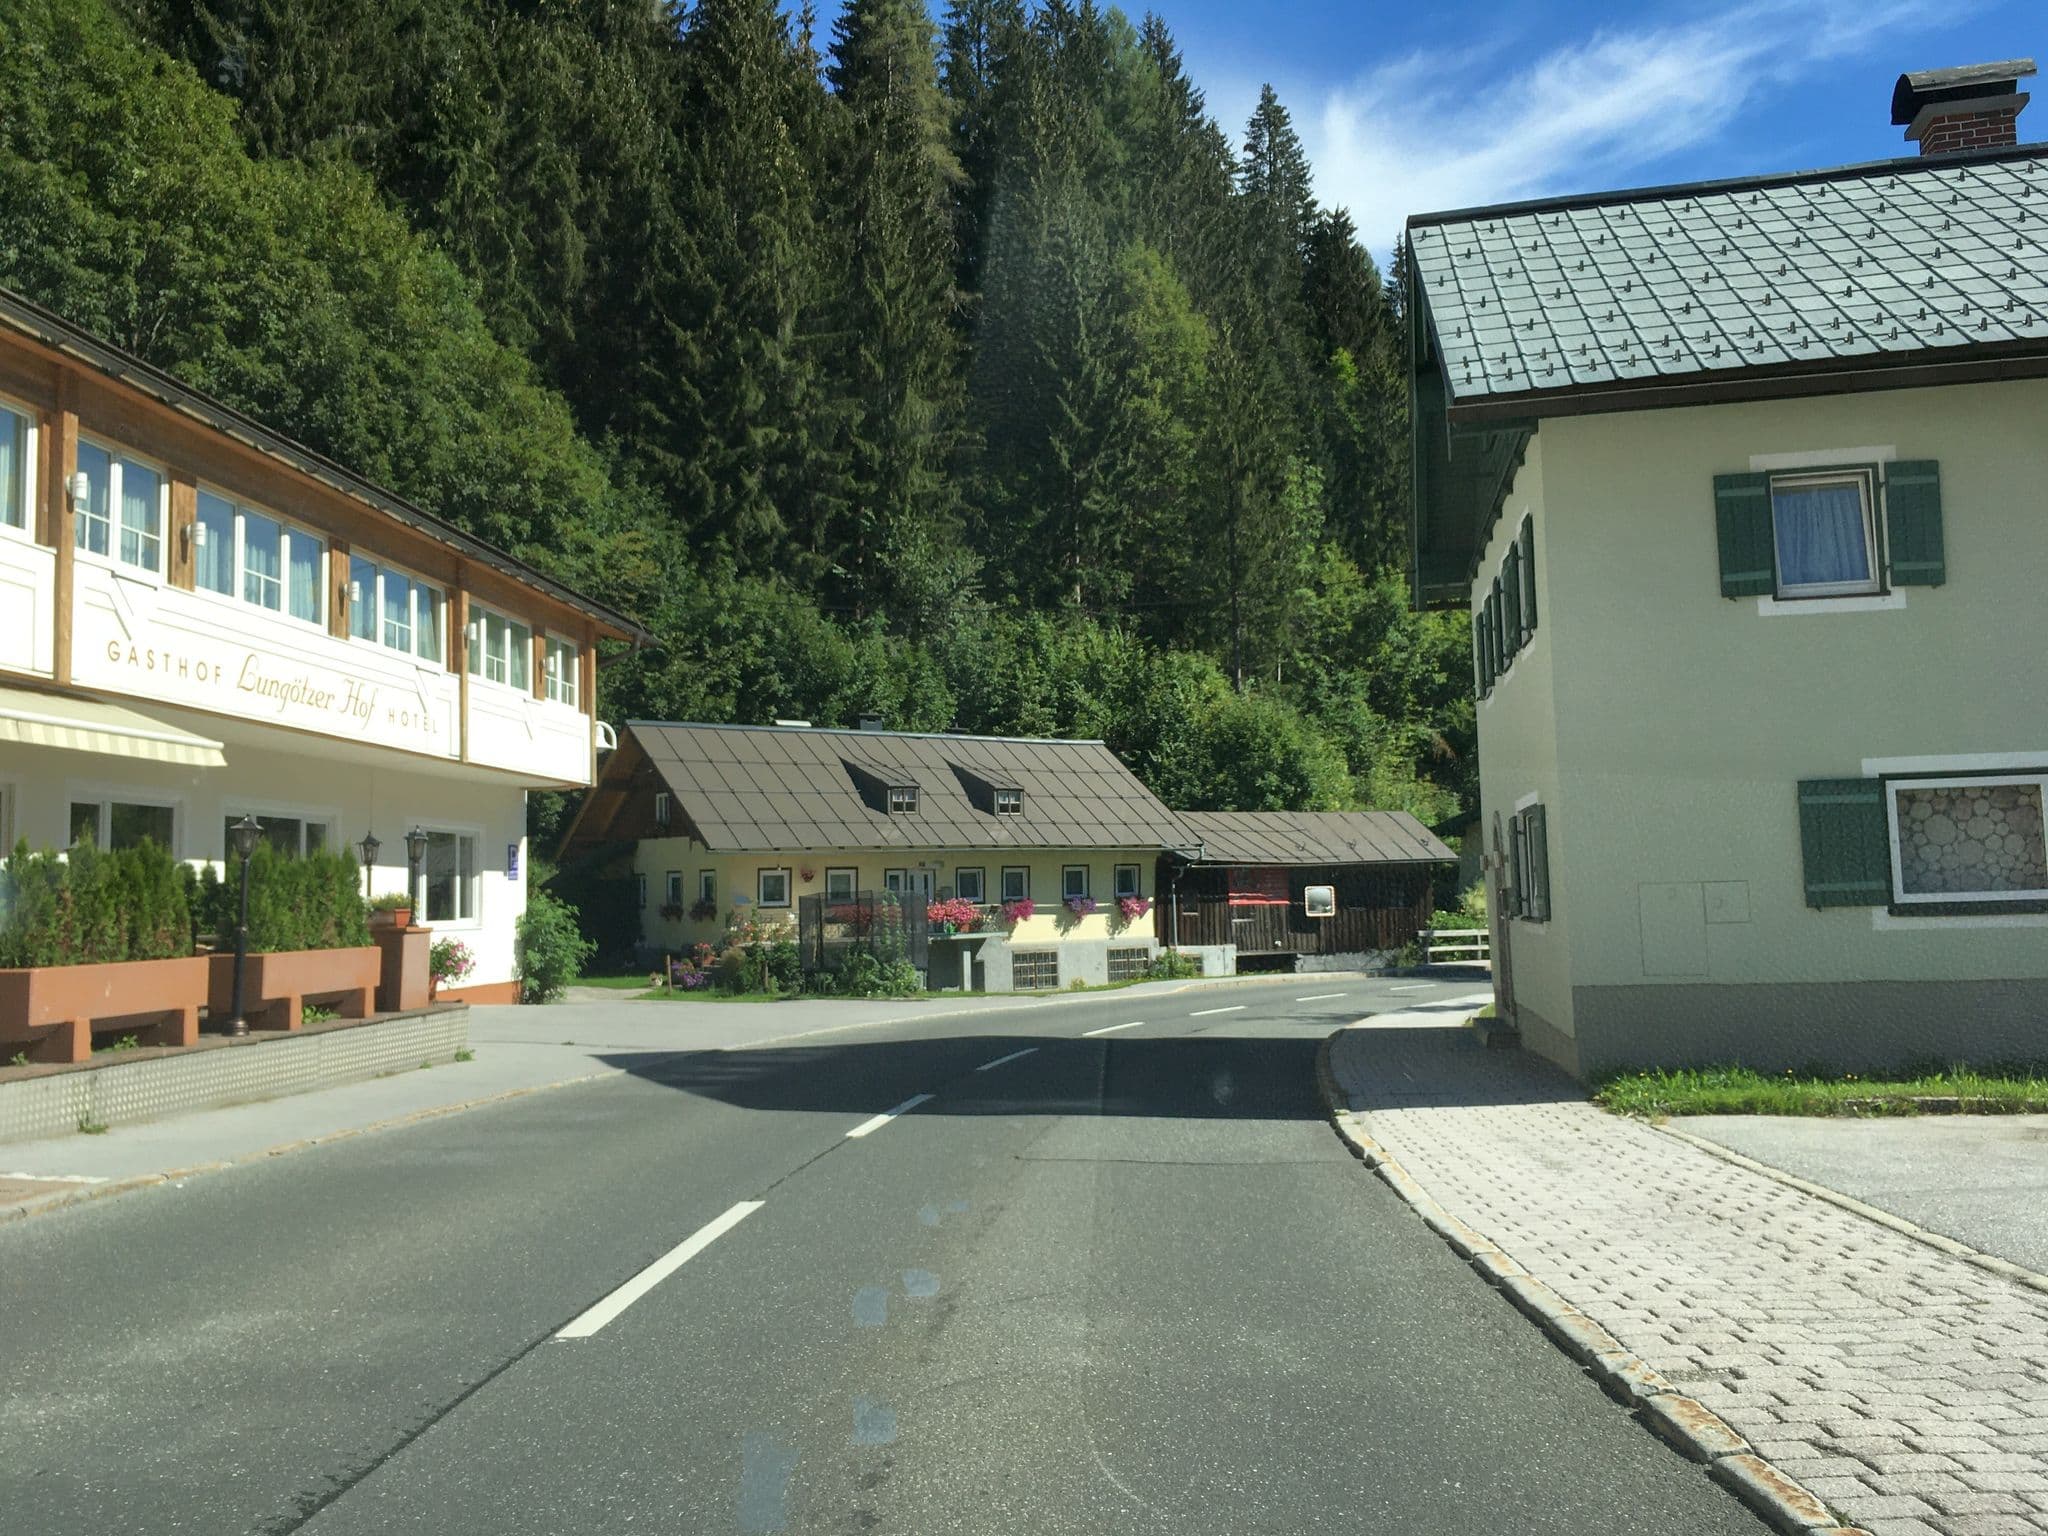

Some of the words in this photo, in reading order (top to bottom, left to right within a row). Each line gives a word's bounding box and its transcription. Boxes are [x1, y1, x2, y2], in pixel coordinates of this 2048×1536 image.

[108, 640, 221, 683] GASTHOF
[237, 654, 335, 711] Lungötzer
[340, 679, 378, 730] Hof
[388, 709, 438, 734] HOTEL
